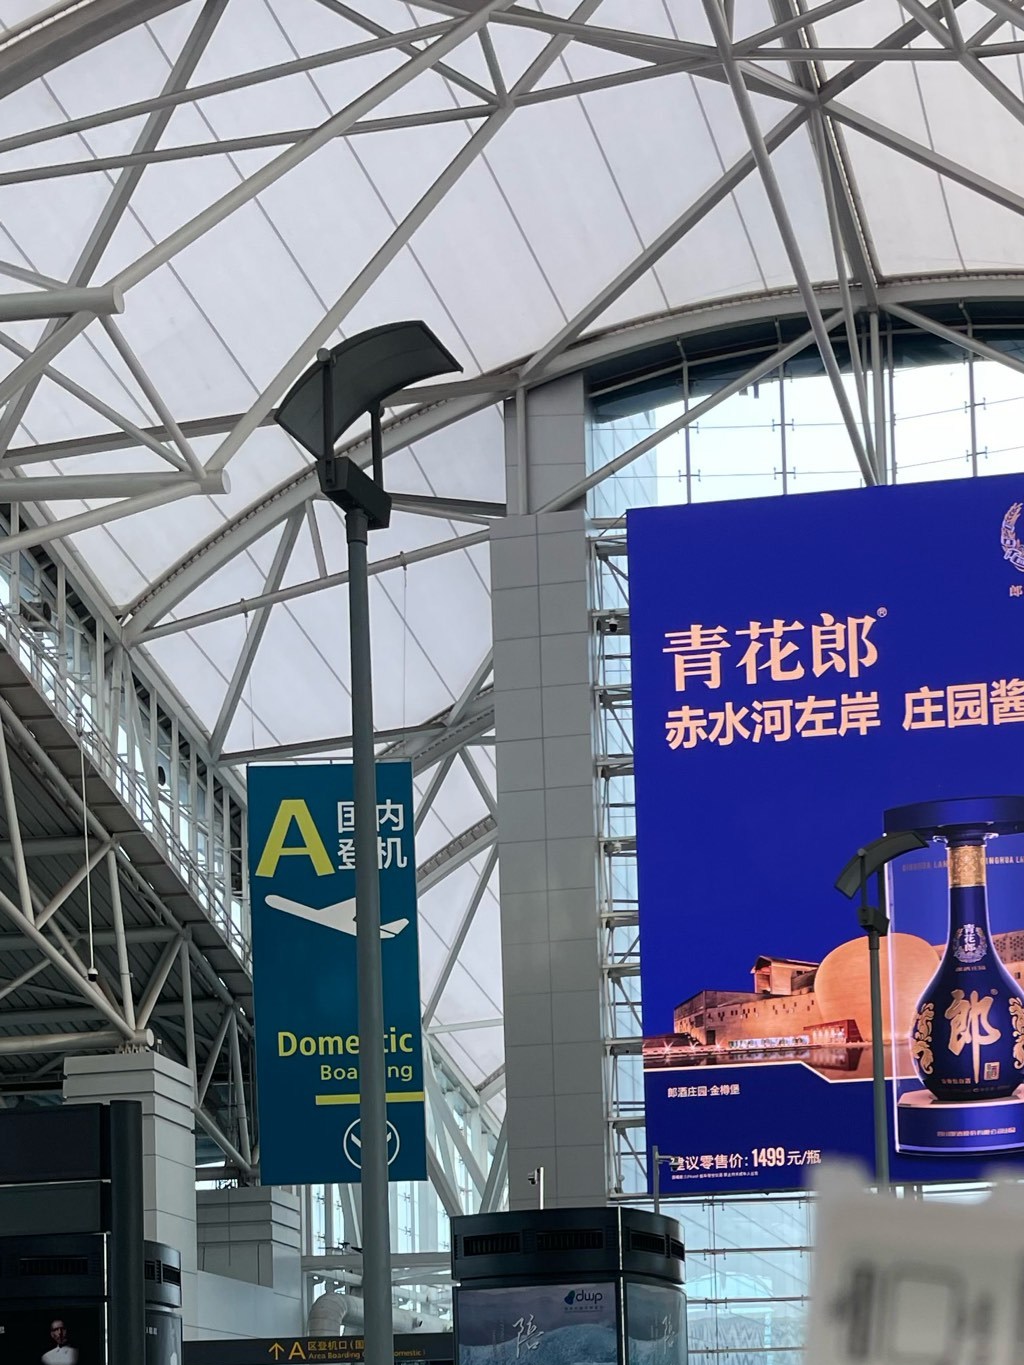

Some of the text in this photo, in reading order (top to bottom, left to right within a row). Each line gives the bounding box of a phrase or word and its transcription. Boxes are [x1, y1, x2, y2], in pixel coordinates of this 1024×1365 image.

[663, 613, 879, 691] 青花郎
[665, 691, 881, 750] 赤水河左岸
[255, 799, 336, 878] A
[278, 1026, 413, 1058] Domeic
[320, 1063, 413, 1082] Boang
[576, 1290, 603, 1304] dwp
[288, 1341, 306, 1360] A
[308, 1339, 365, 1351] 区登机口（国
[308, 1352, 325, 1360] Area
[328, 1350, 361, 1361] Boarding
